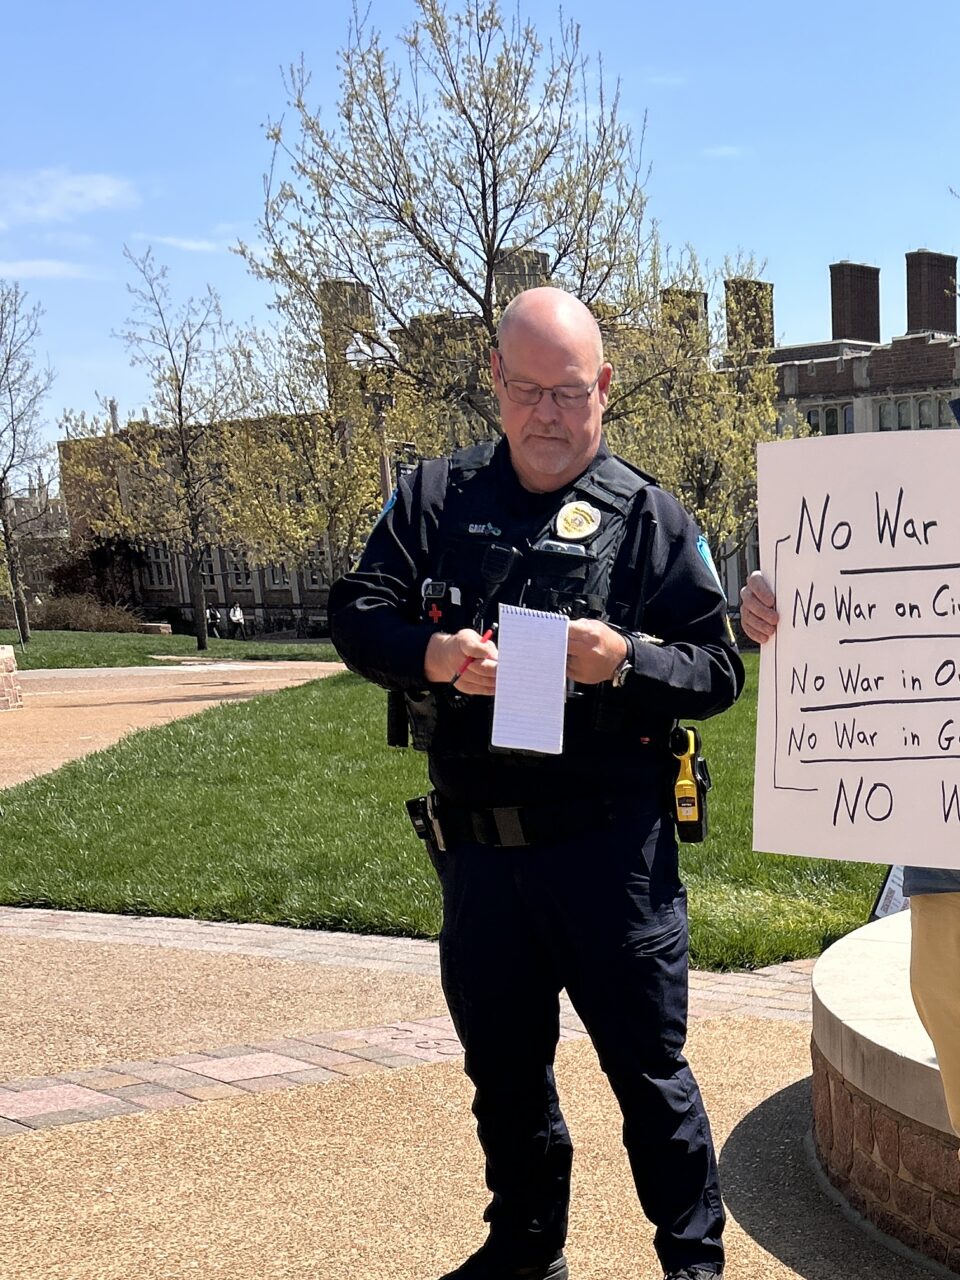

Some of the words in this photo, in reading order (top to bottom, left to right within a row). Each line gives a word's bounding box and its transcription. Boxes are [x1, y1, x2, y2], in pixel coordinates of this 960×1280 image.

[795, 493, 852, 555] No
[875, 486, 937, 549] War
[792, 581, 826, 629] No
[834, 586, 877, 626] War
[894, 602, 922, 619] on
[790, 663, 825, 695] No
[838, 663, 885, 695] War
[902, 671, 922, 691] in
[787, 723, 817, 757] No
[834, 718, 878, 750] War
[902, 729, 920, 748] in
[832, 776, 894, 827] NO
